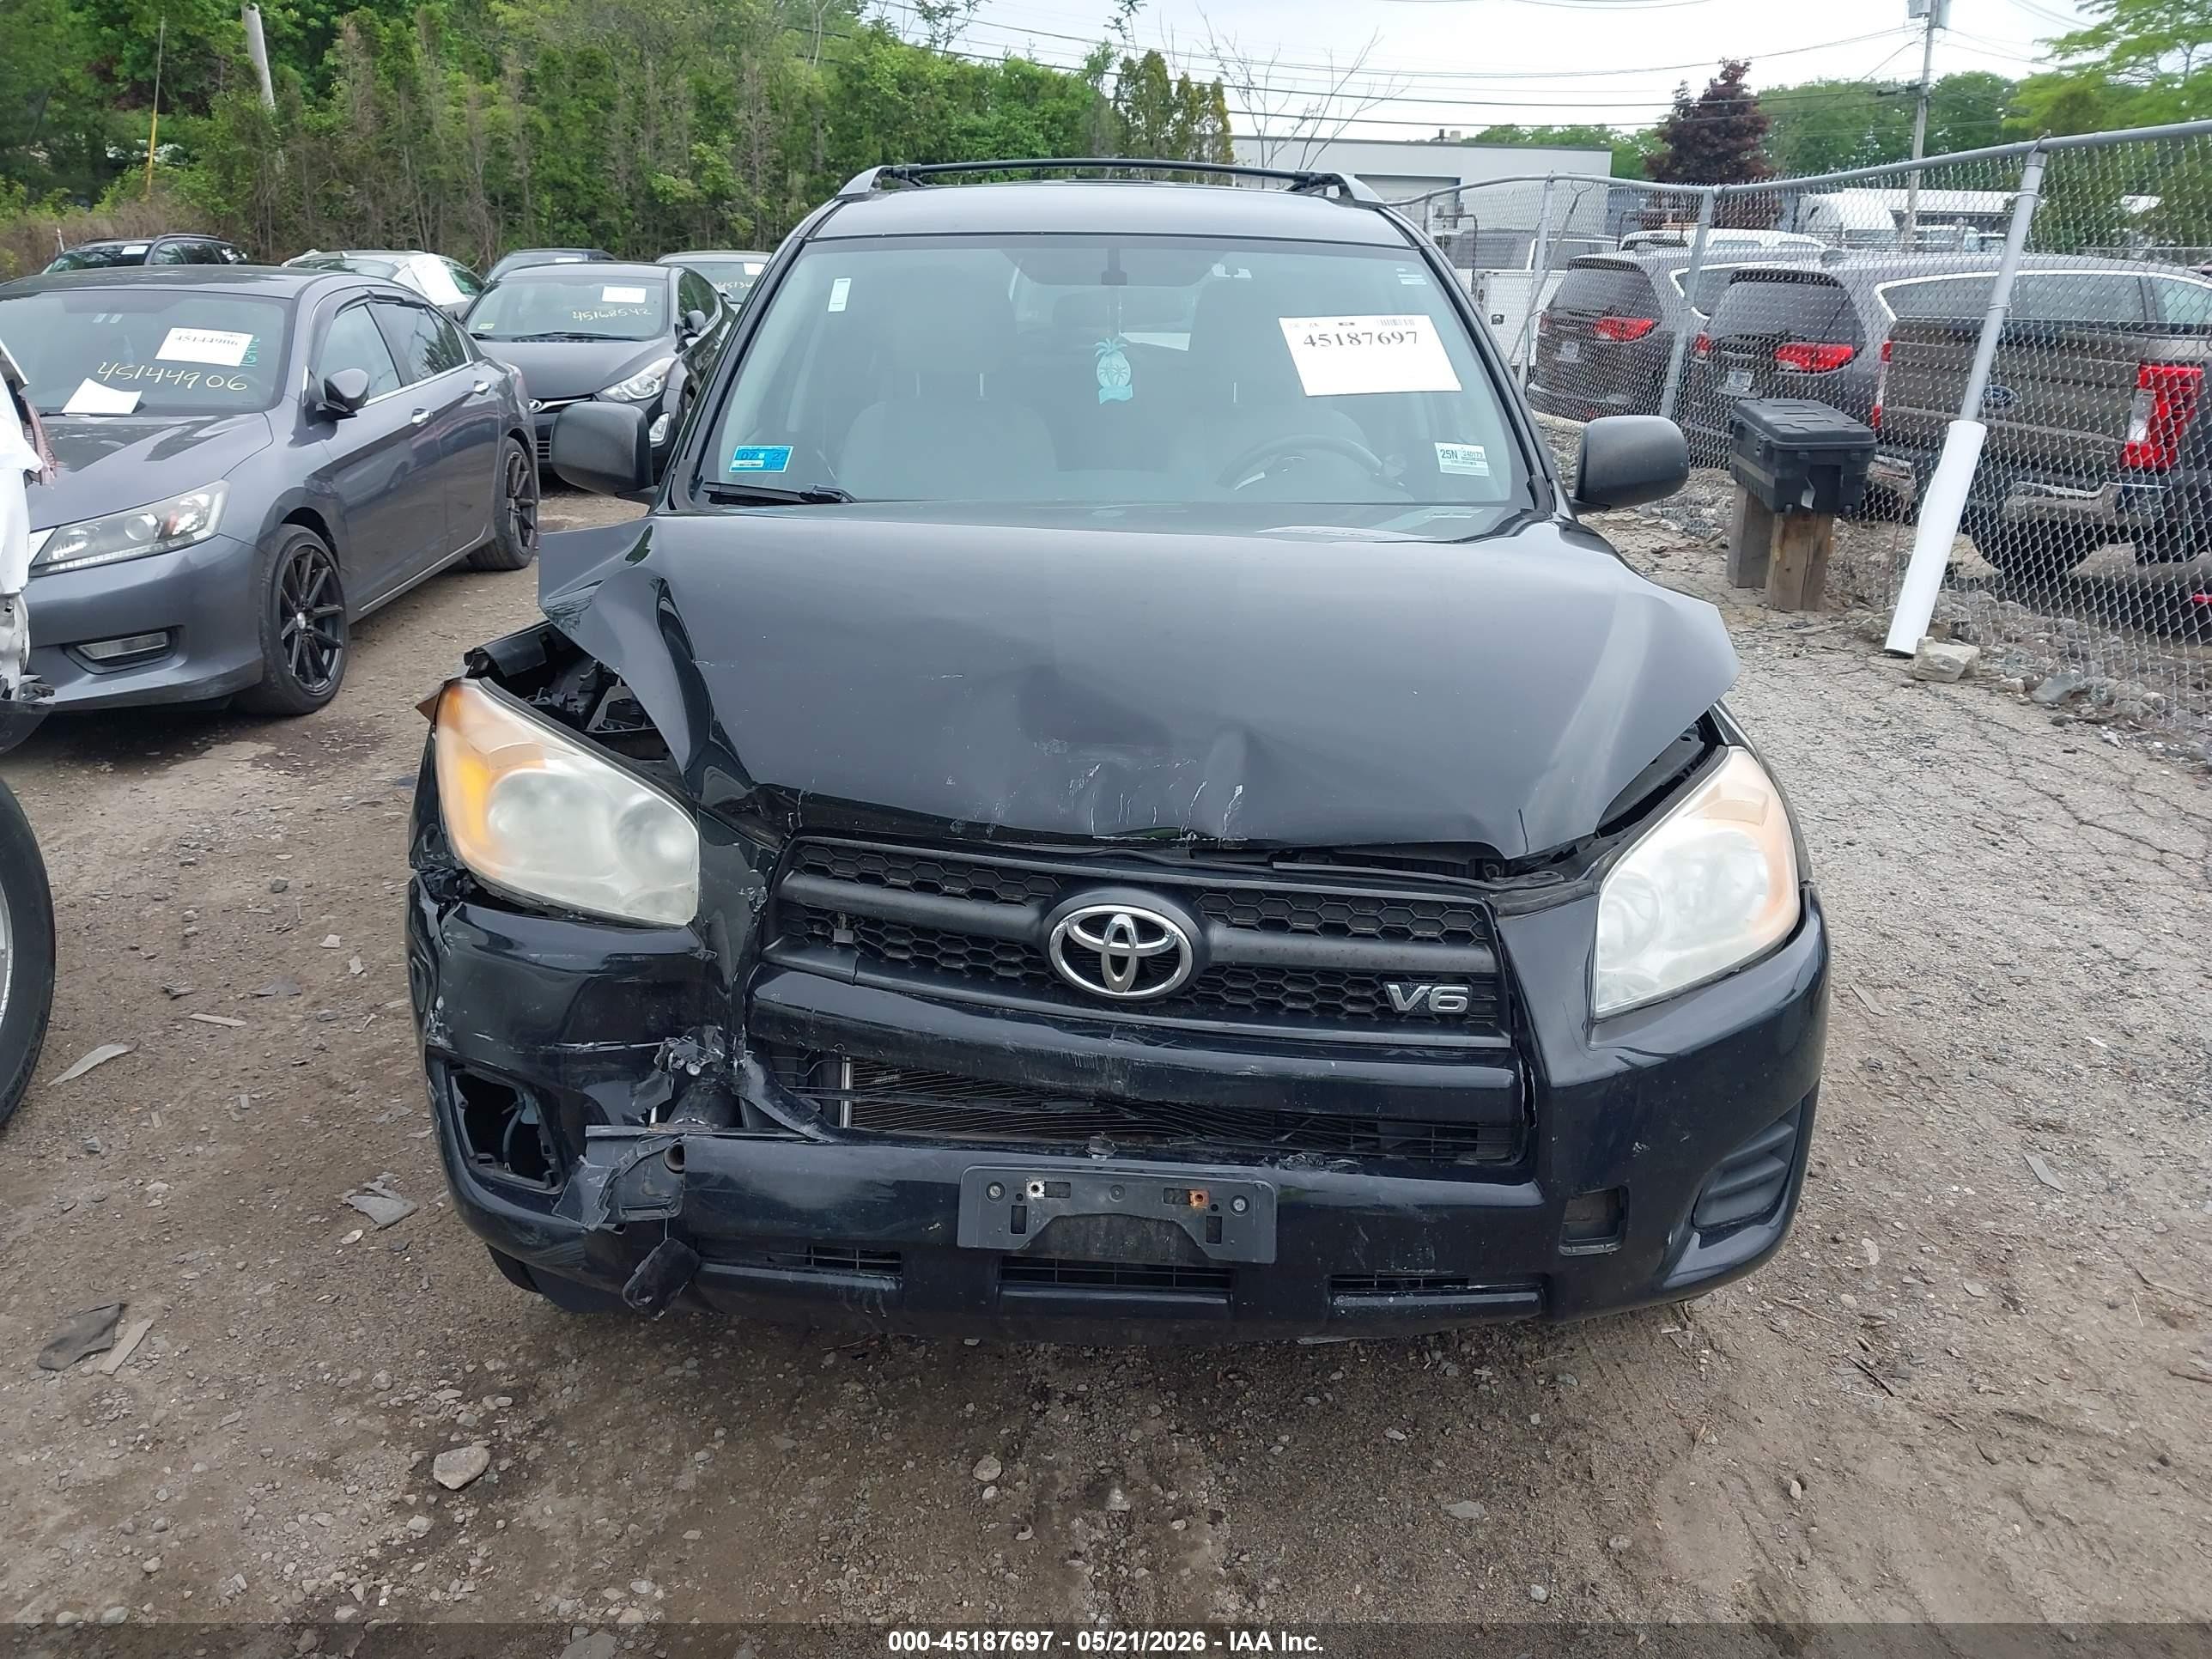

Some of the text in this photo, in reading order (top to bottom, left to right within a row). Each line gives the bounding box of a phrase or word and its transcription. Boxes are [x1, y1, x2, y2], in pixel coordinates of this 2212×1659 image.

[1304, 331, 1418, 347] 45187697
[97, 362, 247, 390] 45144906
[1440, 449, 1458, 459] 25N
[1387, 984, 1469, 1013] V6
